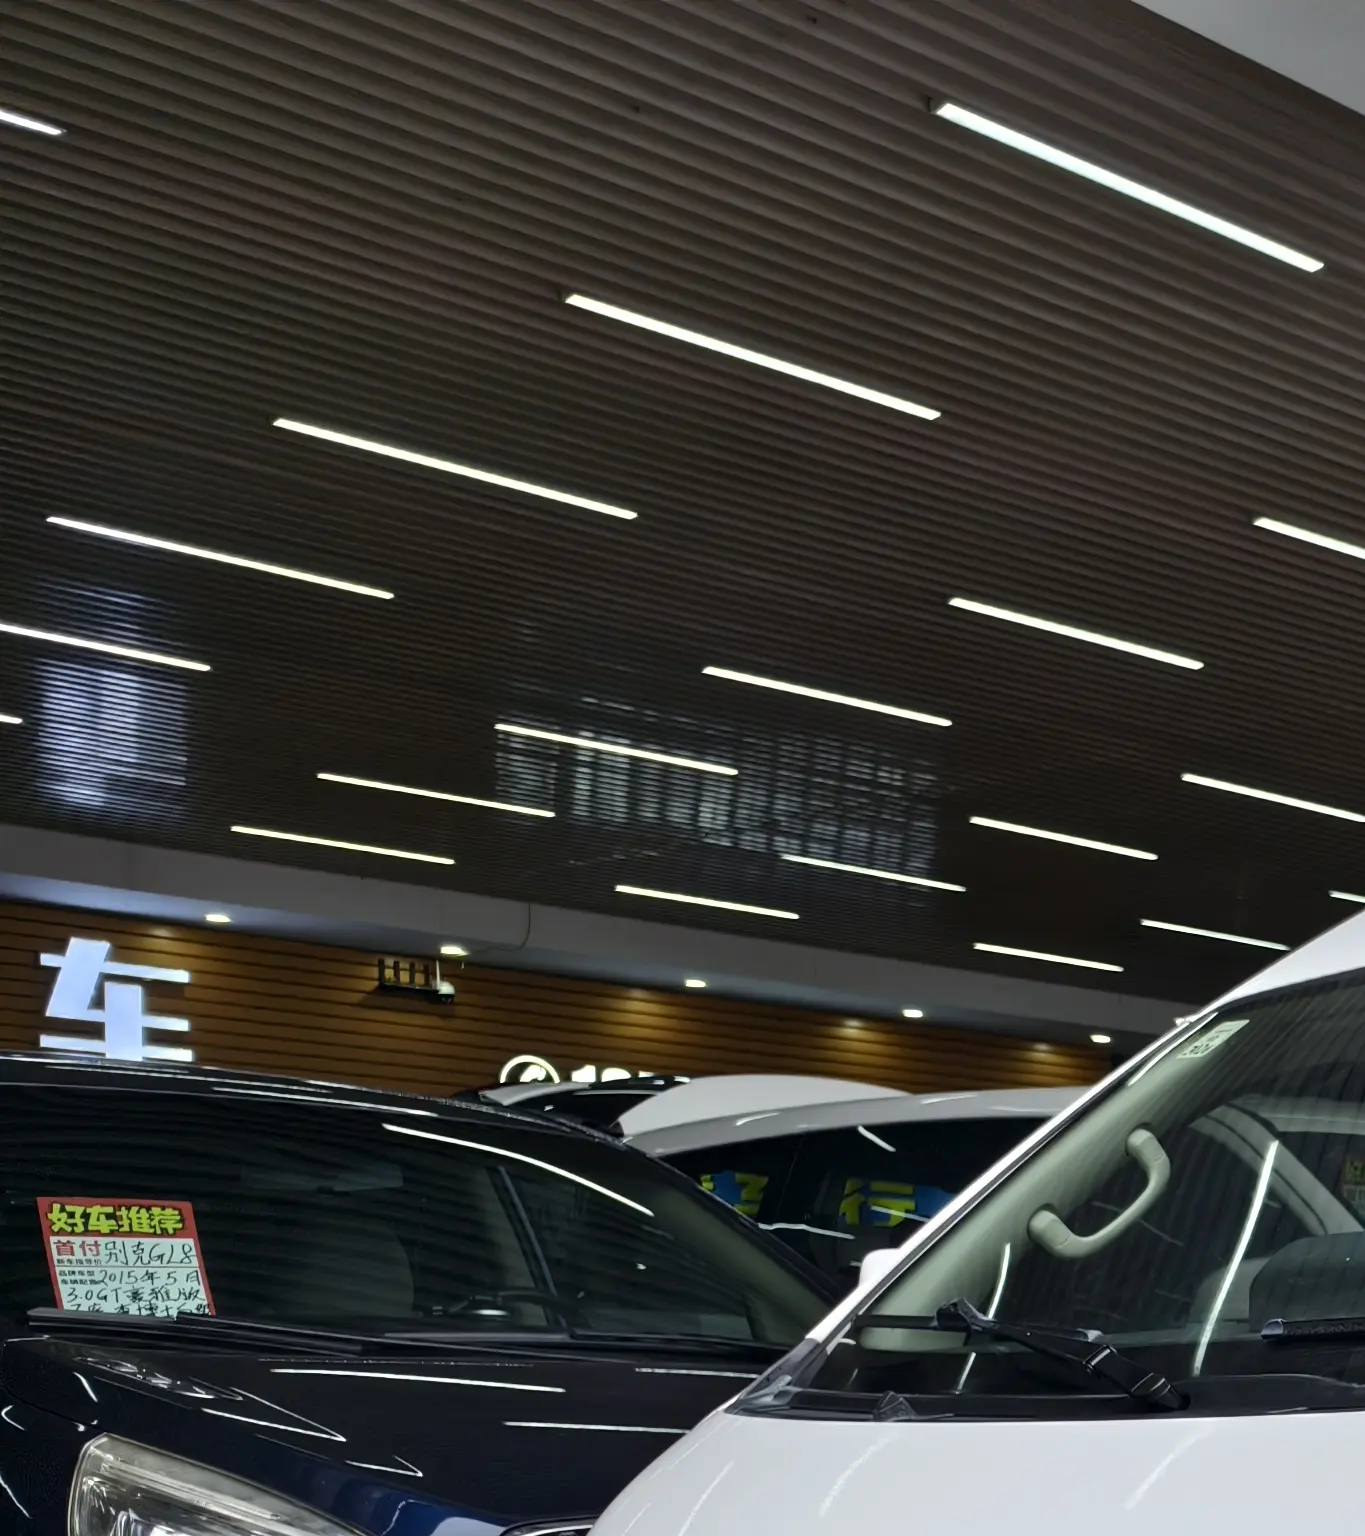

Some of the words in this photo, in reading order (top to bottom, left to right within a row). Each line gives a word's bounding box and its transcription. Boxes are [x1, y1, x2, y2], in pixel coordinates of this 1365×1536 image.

[39, 937, 195, 1061] 车
[47, 1203, 184, 1235] 好车推荐
[53, 1240, 101, 1257] 首付
